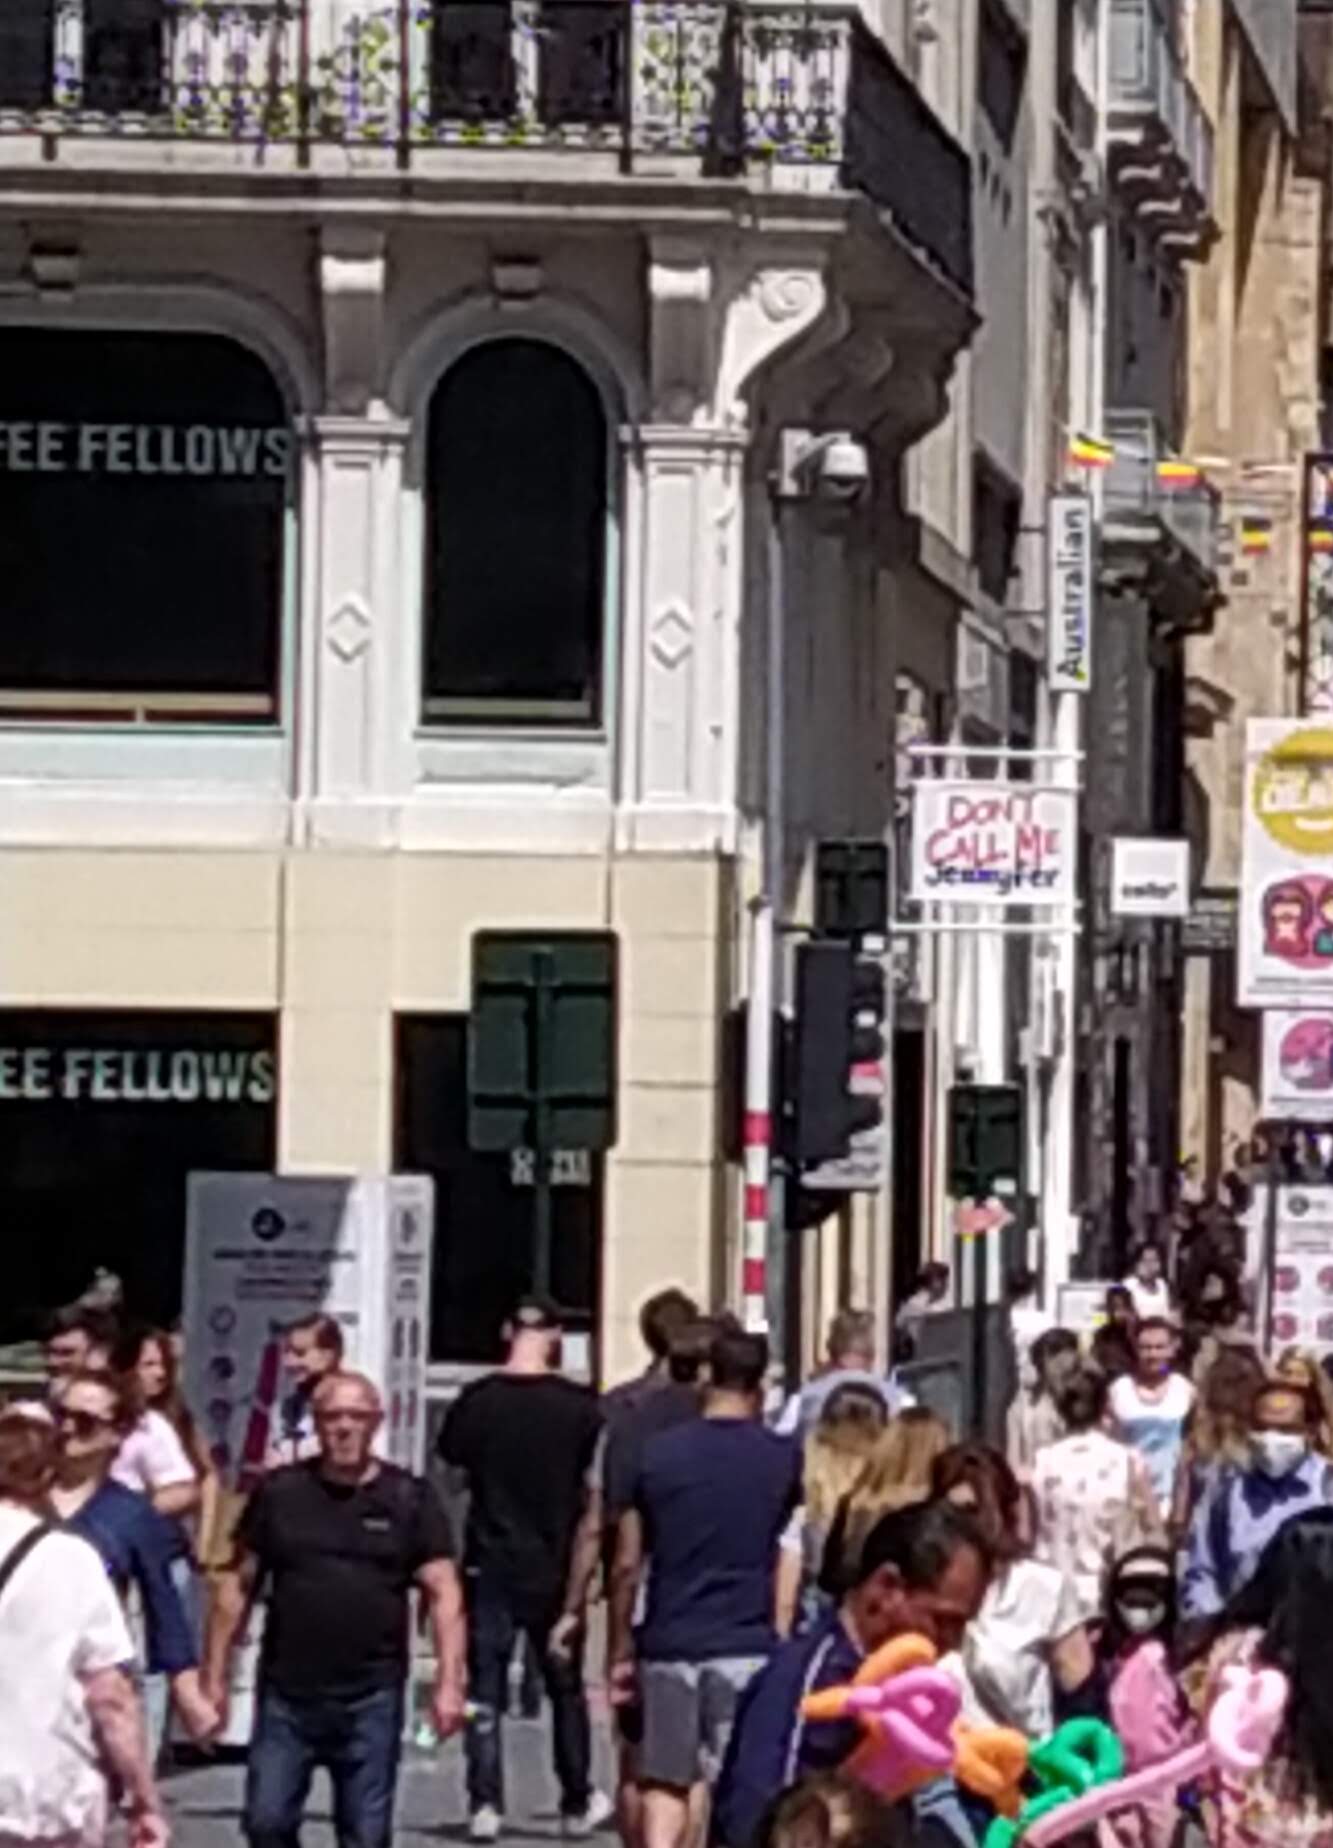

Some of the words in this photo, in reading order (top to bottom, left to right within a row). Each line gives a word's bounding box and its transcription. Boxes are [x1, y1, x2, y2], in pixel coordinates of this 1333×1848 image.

[0, 421, 67, 472] EE
[78, 423, 290, 475] FELLOWS
[1055, 507, 1085, 680] Australian
[925, 826, 1008, 868] CALL
[1015, 822, 1062, 870] ME
[62, 1050, 275, 1103] FELLOWS
